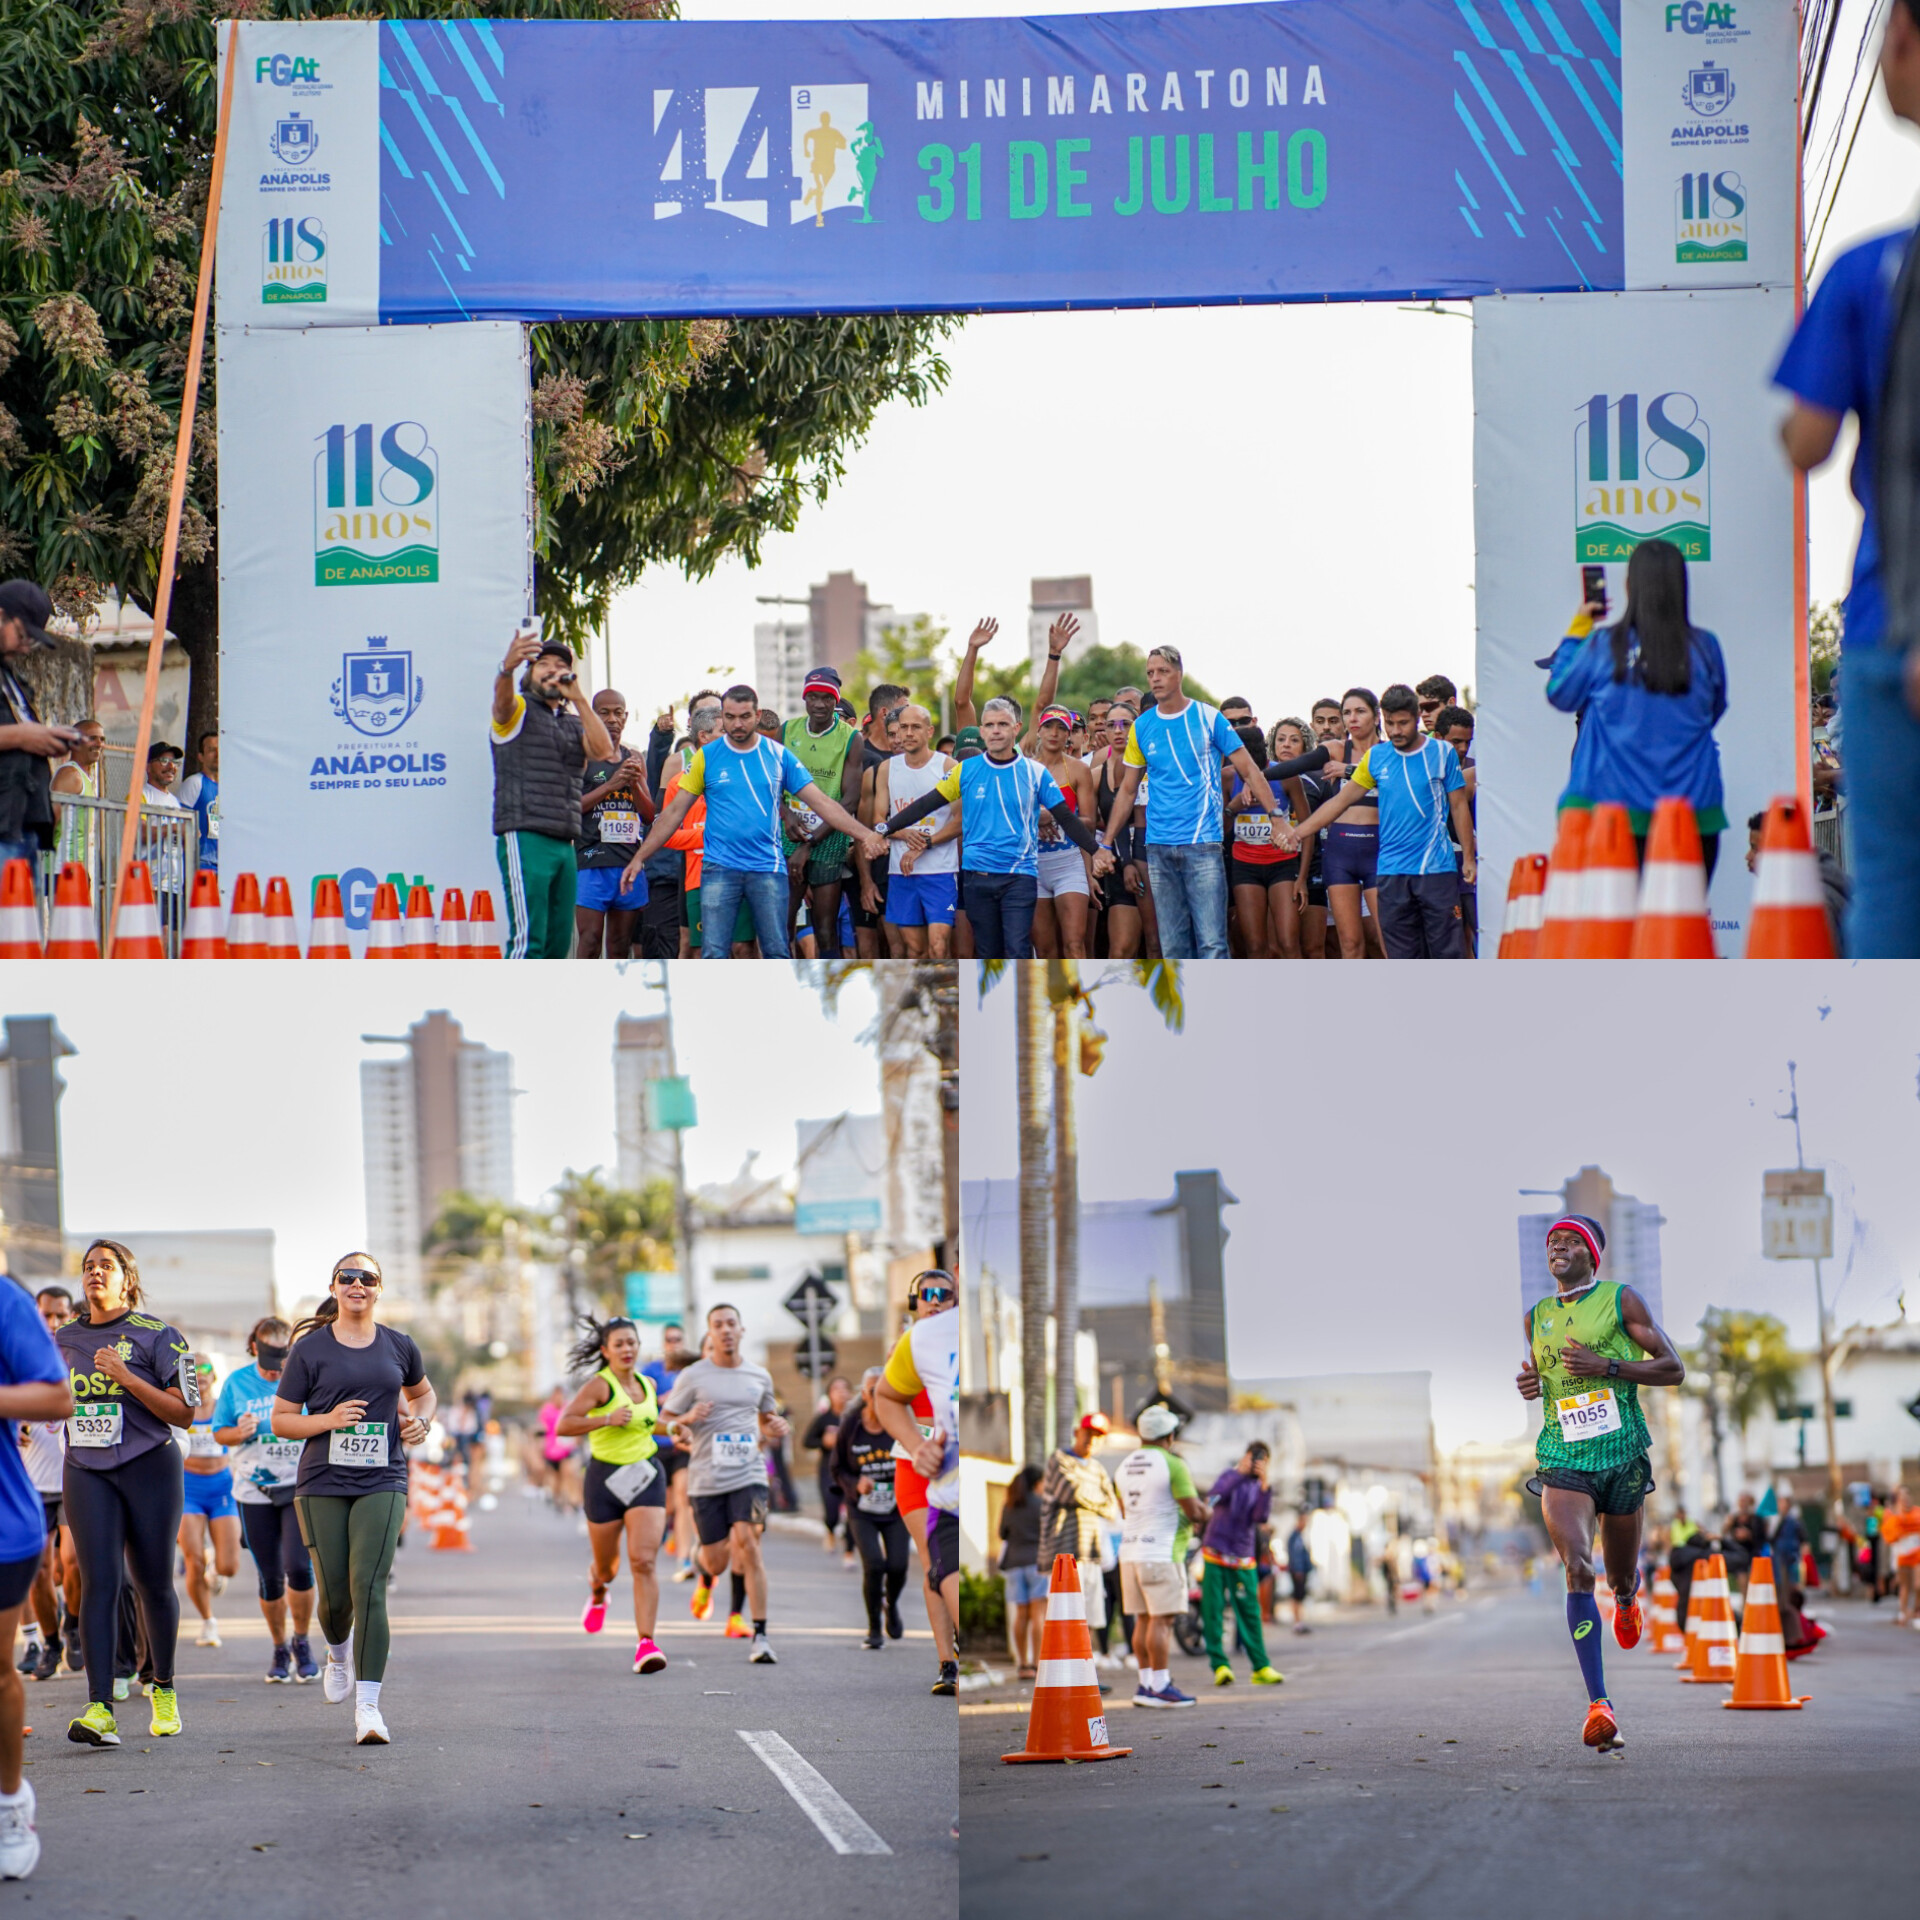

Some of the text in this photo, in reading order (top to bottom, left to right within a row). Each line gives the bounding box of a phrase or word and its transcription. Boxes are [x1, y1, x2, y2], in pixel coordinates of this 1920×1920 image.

[916, 65, 1327, 121] MINIMARATONA
[1671, 124, 1750, 139] ANÁPOLIS
[260, 171, 331, 185] ANÁPOLIS
[916, 128, 1328, 223] 31 DE JULHO
[1675, 170, 1745, 220] 118
[1680, 222, 1743, 238] anos
[262, 216, 325, 263] 118
[267, 265, 324, 280] anos
[1574, 391, 1706, 482] 118
[314, 421, 434, 508] 118
[1585, 486, 1702, 516] anos
[324, 510, 433, 541] anos
[1586, 544, 1609, 556] DE
[325, 564, 430, 579] DE ANÁPOLIS
[337, 741, 419, 751] PREFEITURA DE
[310, 751, 447, 776] ANÁPOLIS
[310, 777, 447, 790] SEMPRE DO SEU LADO
[608, 822, 634, 834] 1058
[1242, 825, 1271, 837] 1072
[1711, 920, 1741, 930] OIANA
[1562, 1377, 1583, 1388] FISIO
[1569, 1404, 1607, 1425] 1055
[77, 1419, 112, 1433] 5332
[266, 1445, 299, 1457] 4459
[340, 1438, 379, 1453] 4572
